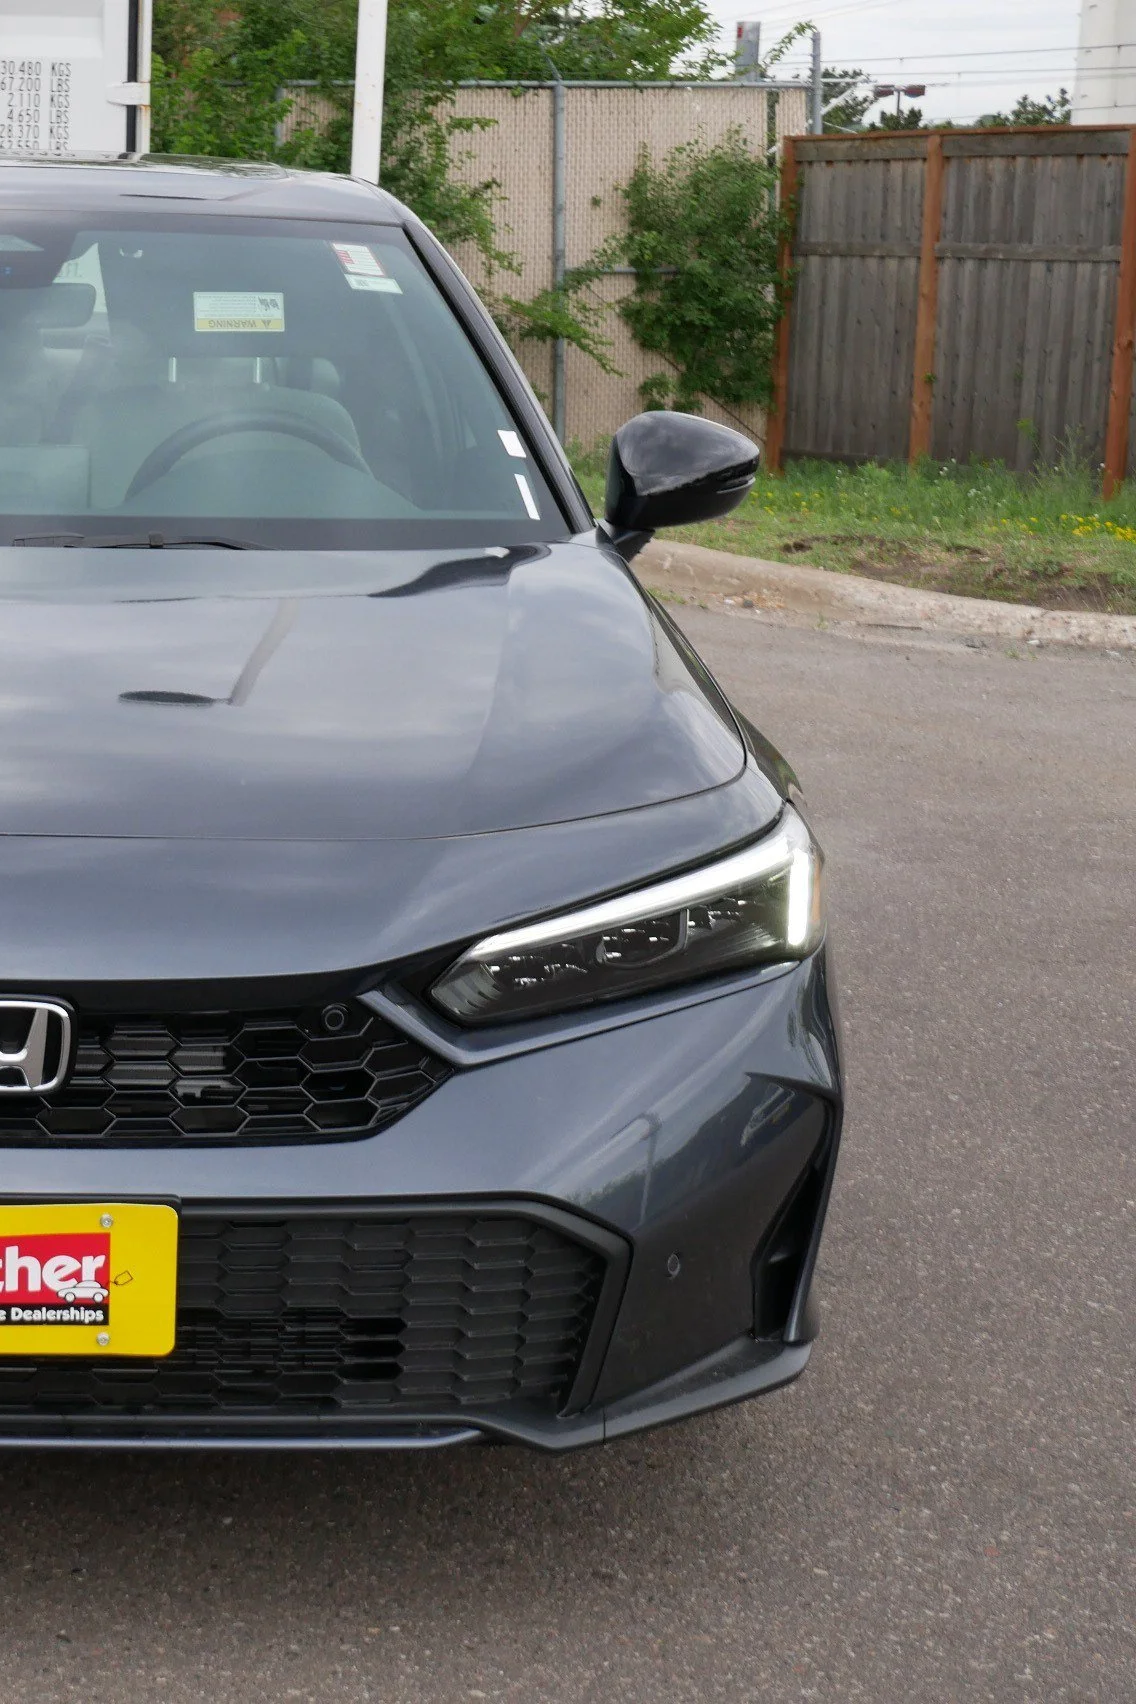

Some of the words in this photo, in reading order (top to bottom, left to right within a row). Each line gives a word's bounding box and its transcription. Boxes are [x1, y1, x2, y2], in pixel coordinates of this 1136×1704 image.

[51, 62, 71, 77] KGS
[50, 78, 70, 93] LBS
[50, 94, 70, 108] KGS
[49, 109, 70, 124] LBS
[48, 125, 69, 140] KGS
[208, 319, 257, 328] WARNING
[10, 1306, 105, 1324] Dealerships
